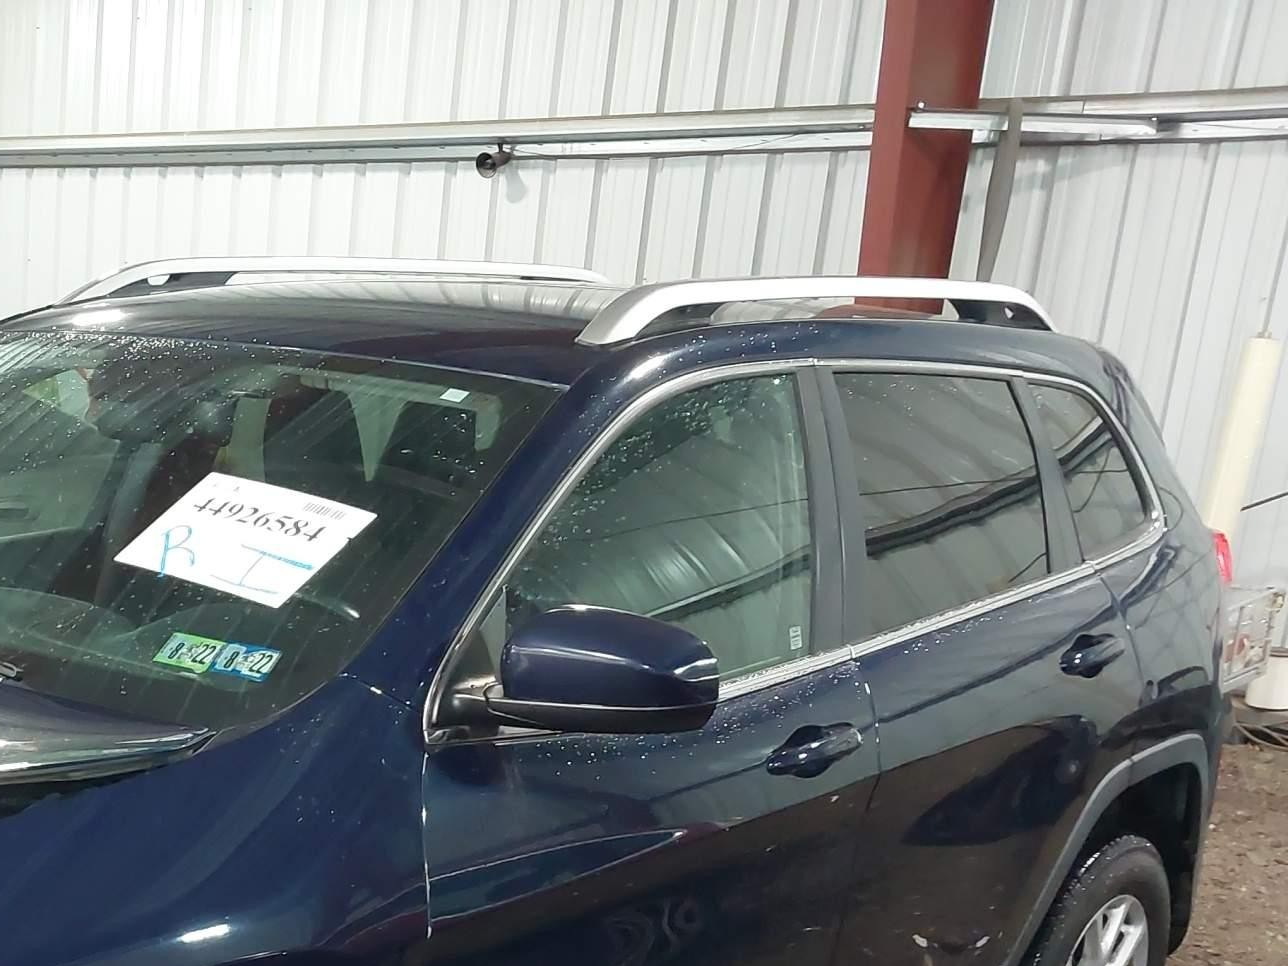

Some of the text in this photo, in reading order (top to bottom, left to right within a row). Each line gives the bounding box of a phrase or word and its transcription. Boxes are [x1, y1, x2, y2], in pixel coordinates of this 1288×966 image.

[193, 497, 327, 542] 44926584
[156, 524, 195, 578] R
[192, 643, 217, 665] 22
[249, 652, 273, 674] 22
